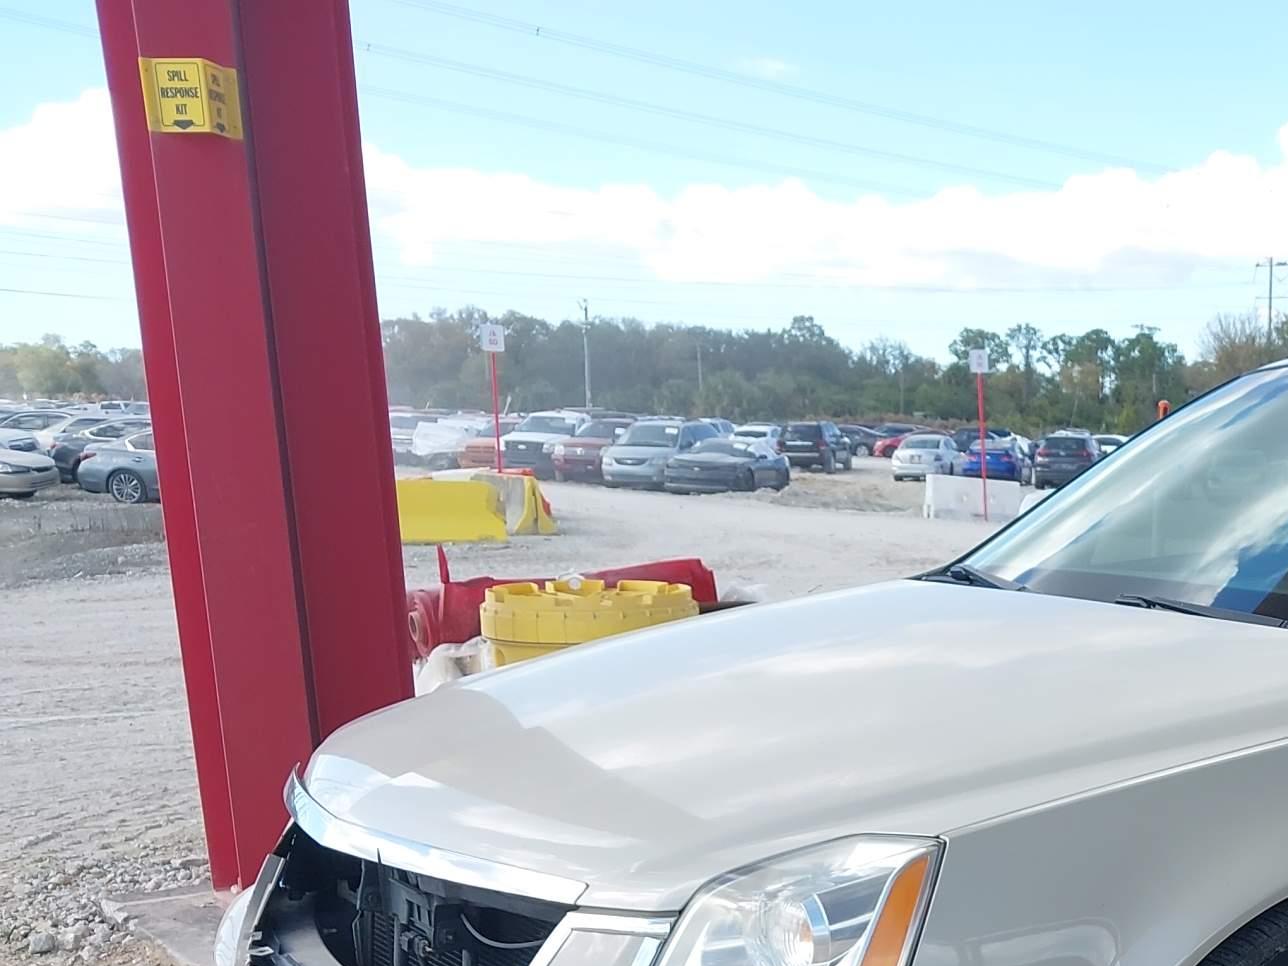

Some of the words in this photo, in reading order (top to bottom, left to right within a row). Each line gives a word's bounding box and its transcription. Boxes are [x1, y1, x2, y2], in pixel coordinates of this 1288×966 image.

[167, 70, 189, 81] SPILL
[160, 87, 199, 98] RESPONSE
[176, 104, 187, 114] KIT
